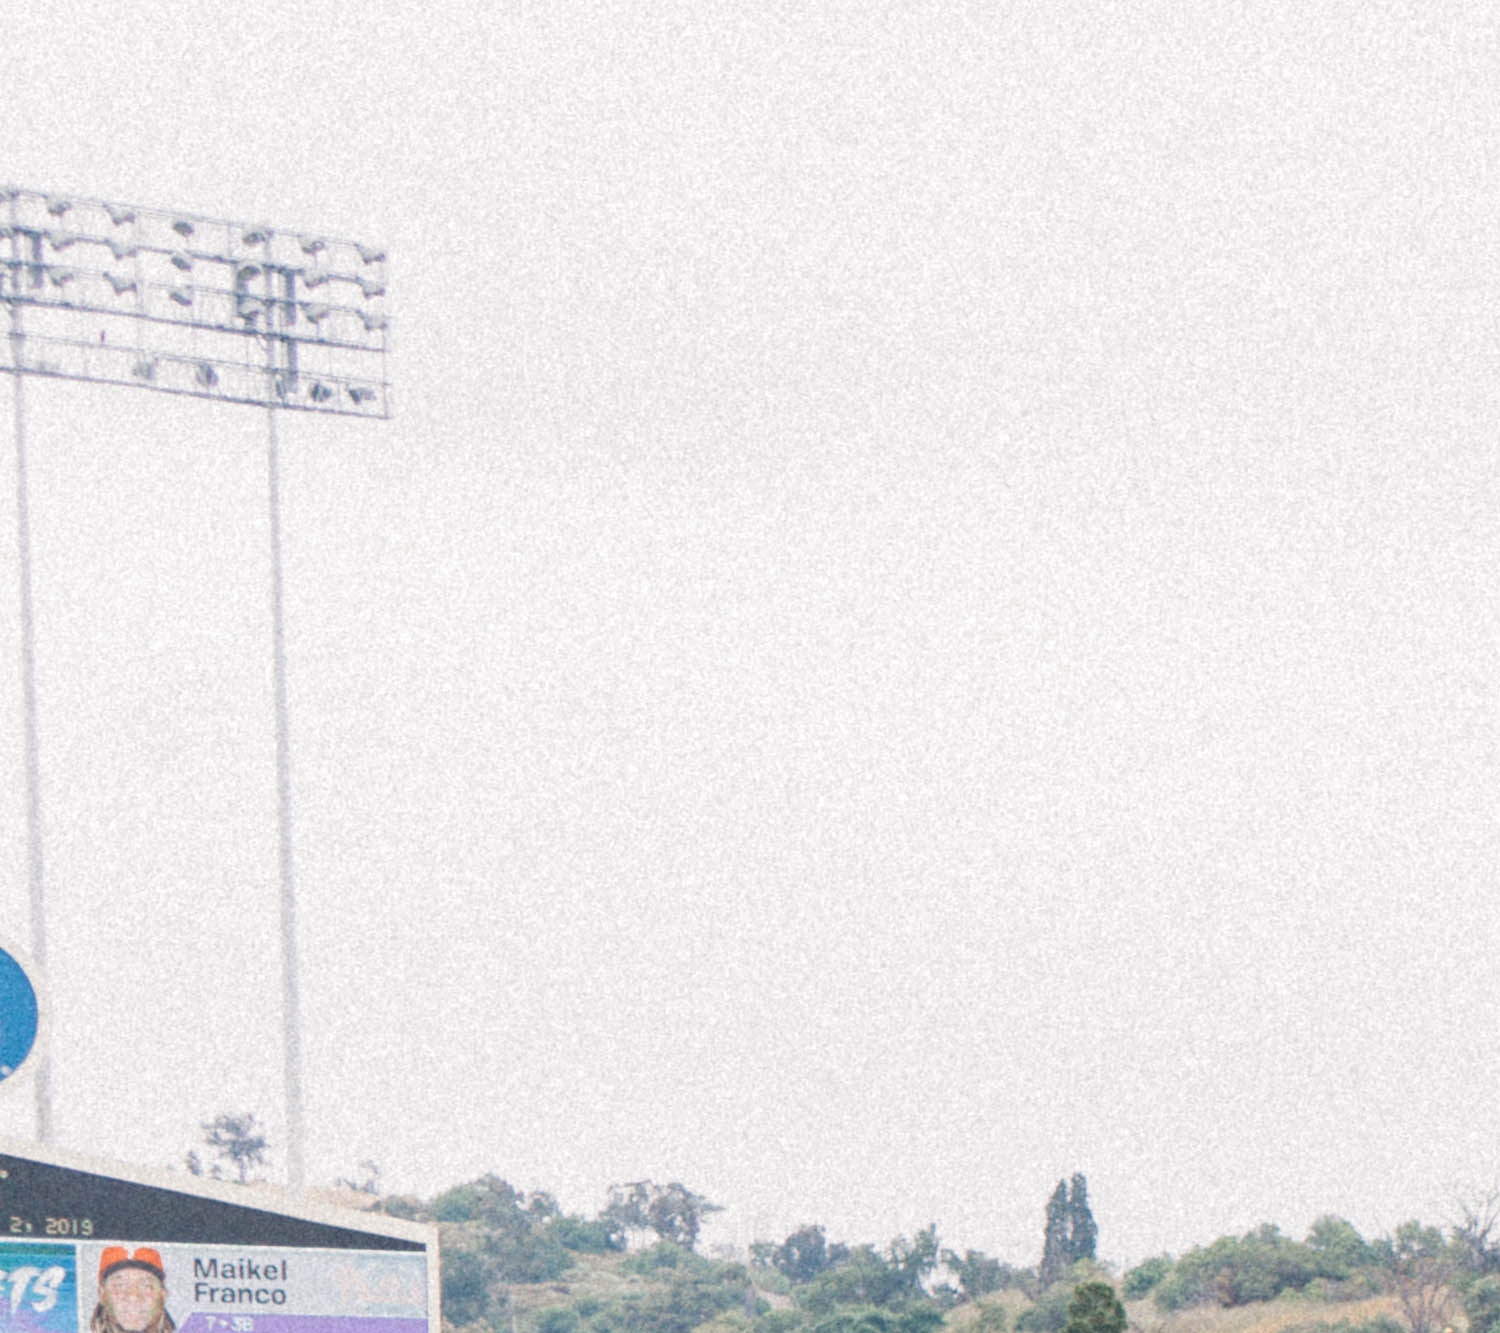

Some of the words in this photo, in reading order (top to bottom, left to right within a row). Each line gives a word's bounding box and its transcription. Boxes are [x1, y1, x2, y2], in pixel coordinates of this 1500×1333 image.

[45, 1218, 94, 1236] 2019
[193, 1258, 288, 1281] Maikel
[194, 1283, 287, 1304] Franco
